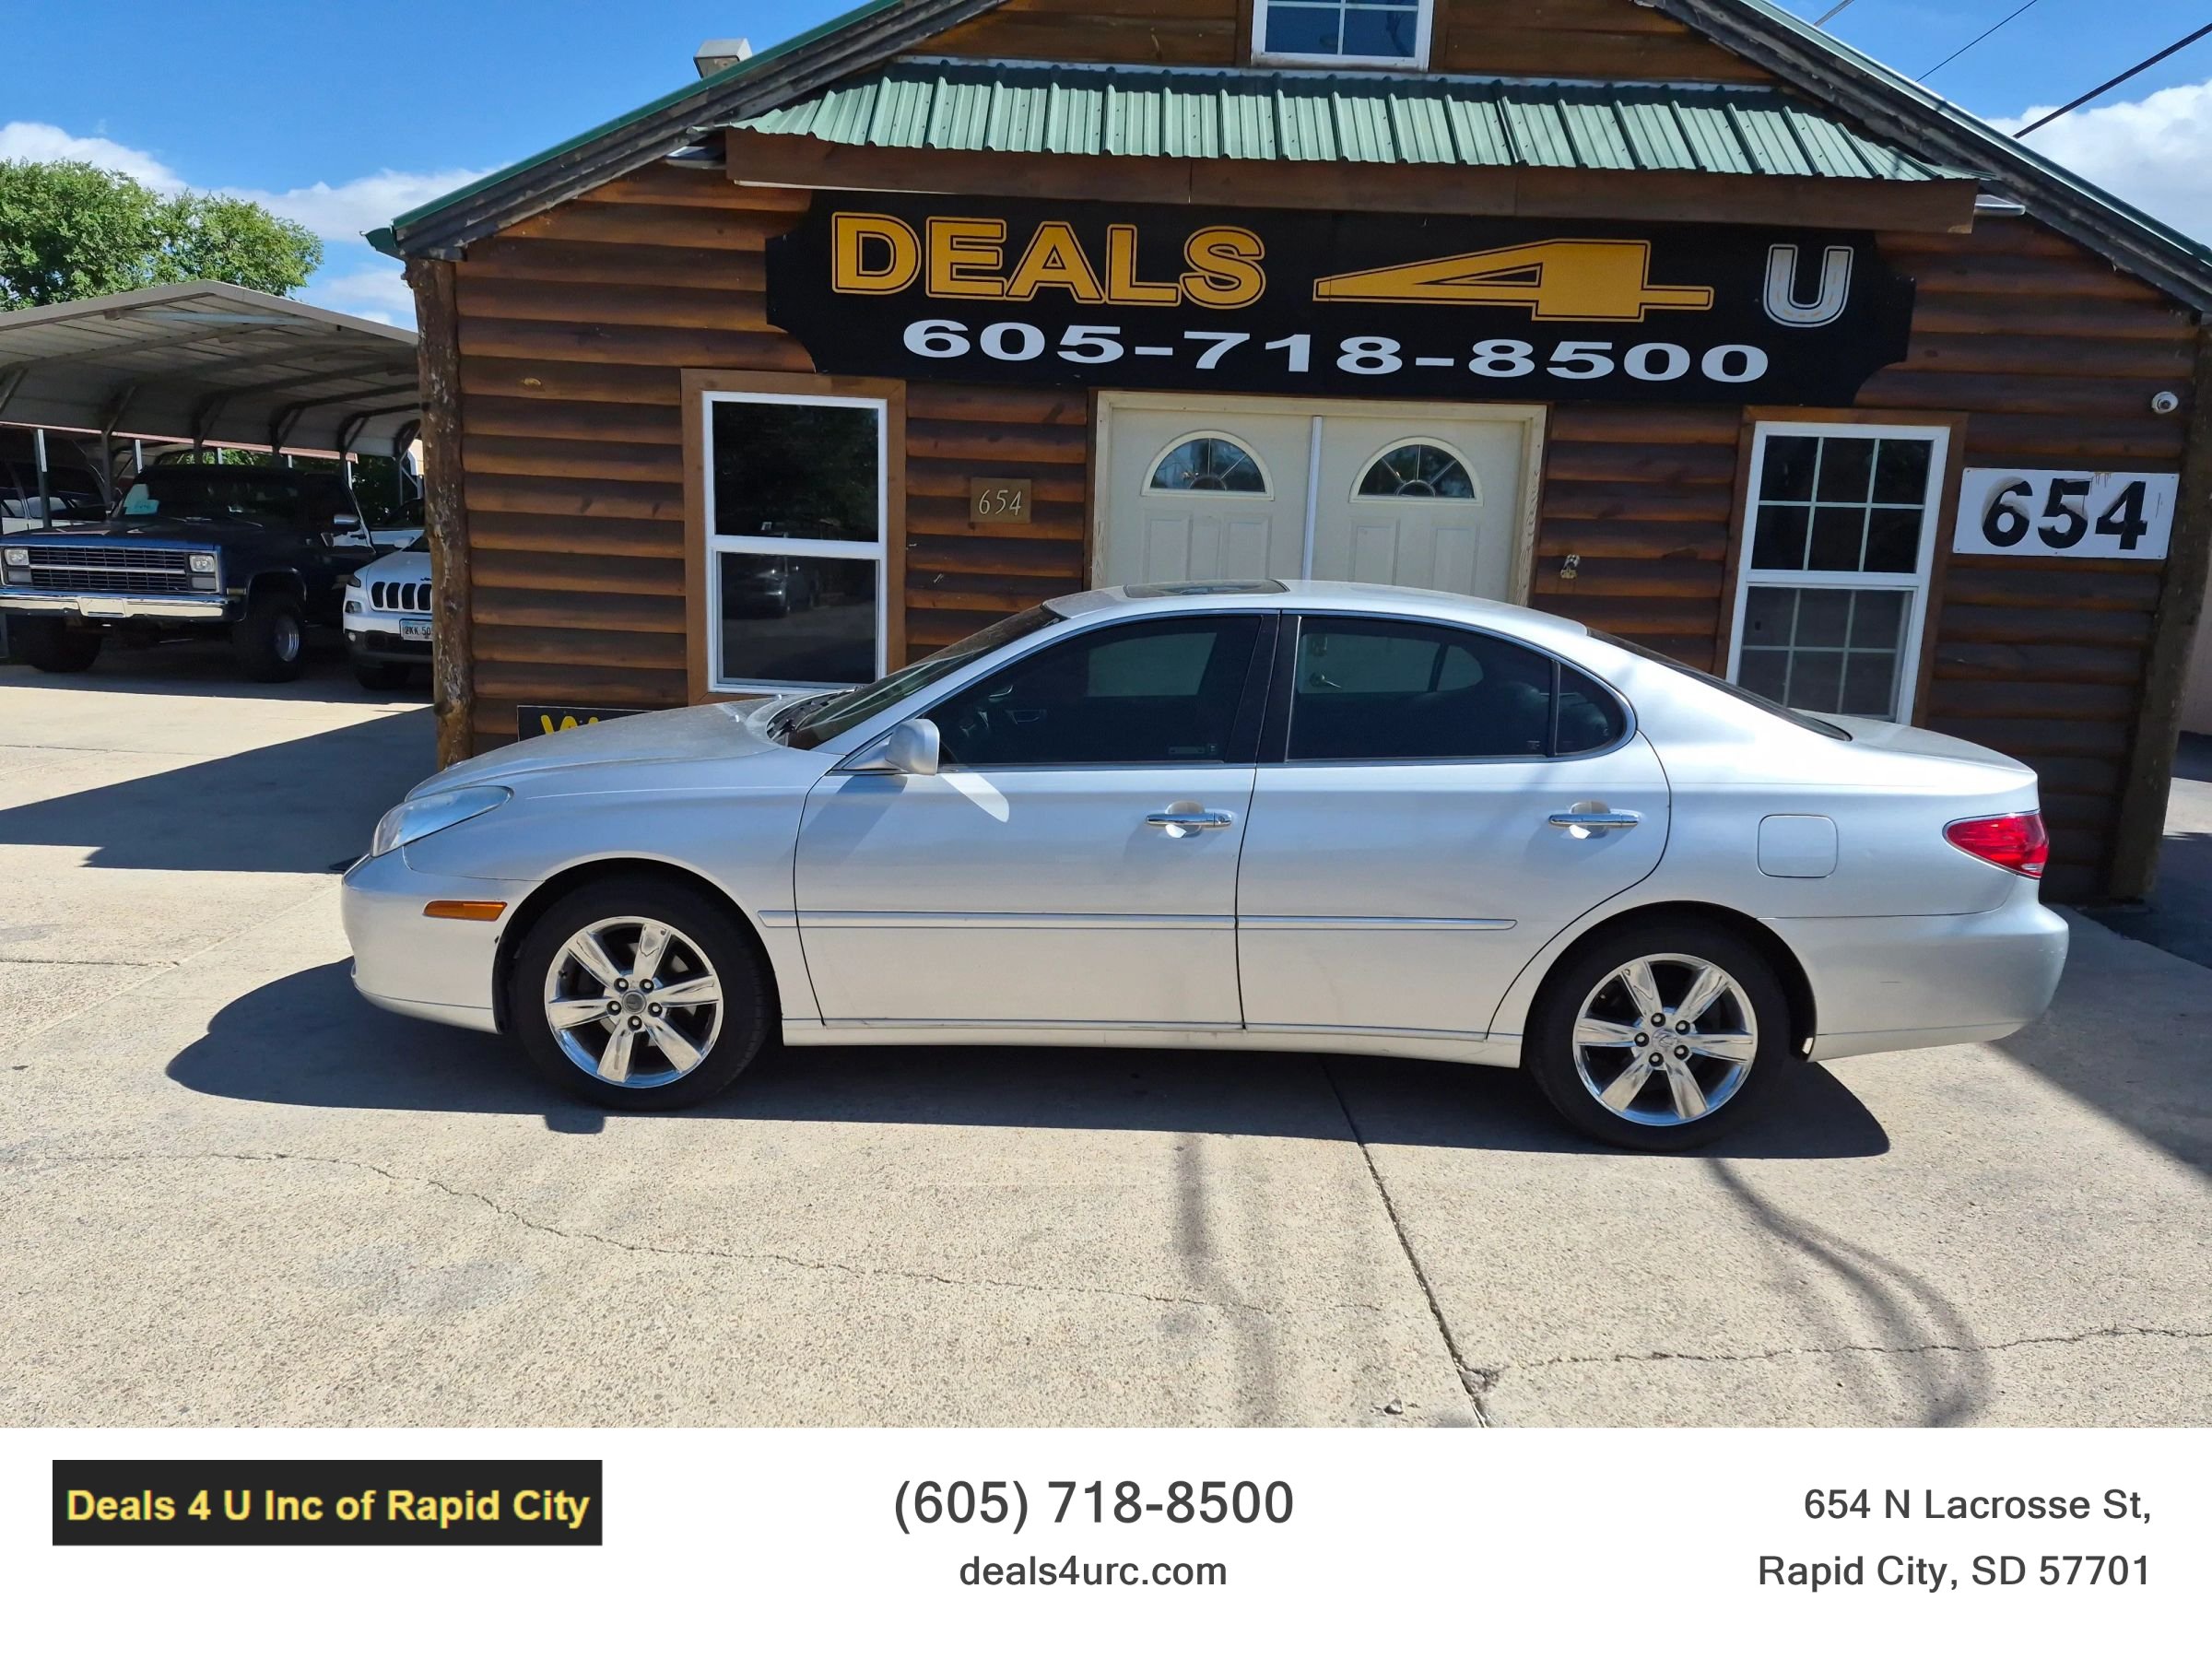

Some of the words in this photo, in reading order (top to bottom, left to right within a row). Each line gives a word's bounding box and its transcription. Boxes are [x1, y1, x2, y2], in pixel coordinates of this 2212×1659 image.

[831, 212, 1266, 309] DEALS
[1312, 237, 1715, 324] 4
[1762, 241, 1854, 328] U
[901, 318, 1771, 384] 605-718-8500
[979, 489, 1022, 516] 654
[1982, 477, 2149, 550] 654
